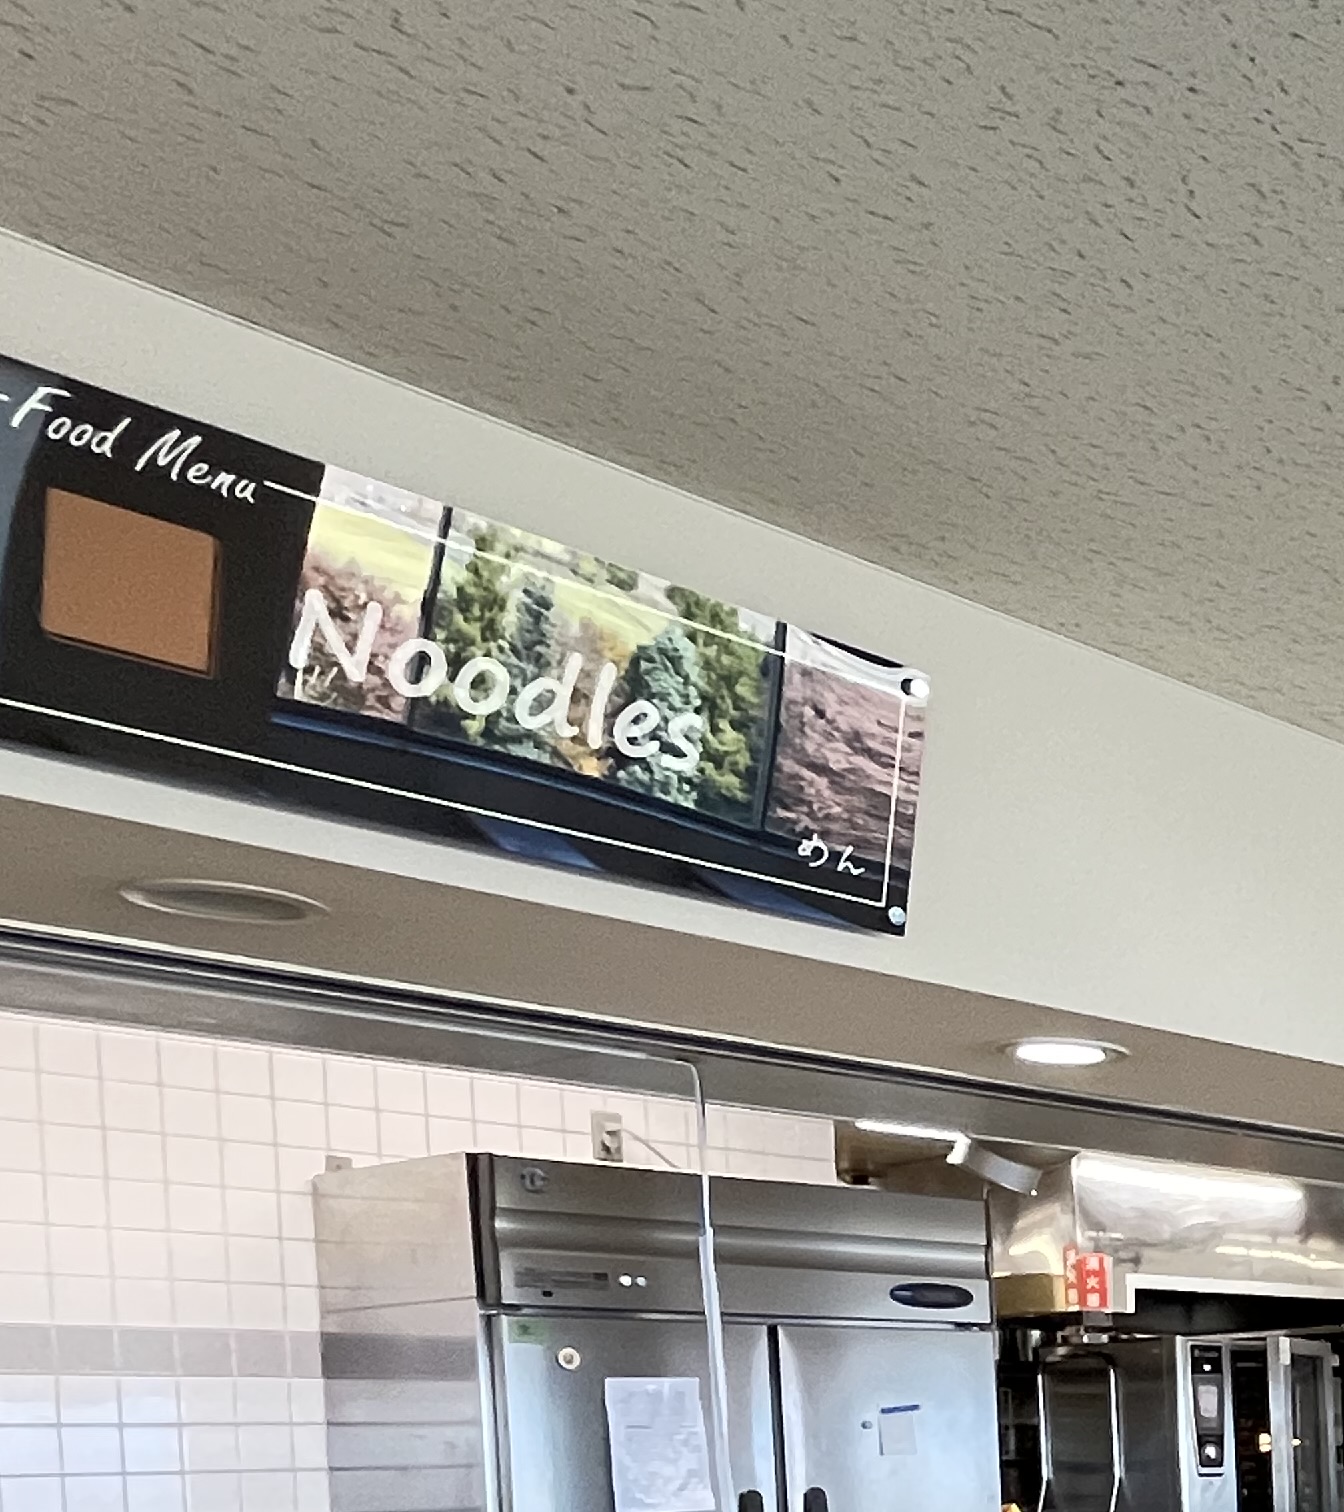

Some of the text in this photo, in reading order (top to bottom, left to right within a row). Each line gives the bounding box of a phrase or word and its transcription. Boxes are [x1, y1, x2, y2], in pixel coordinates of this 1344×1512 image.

[9, 386, 256, 503] Food Menu
[289, 588, 703, 772] Noodles
[797, 833, 866, 876] めん
